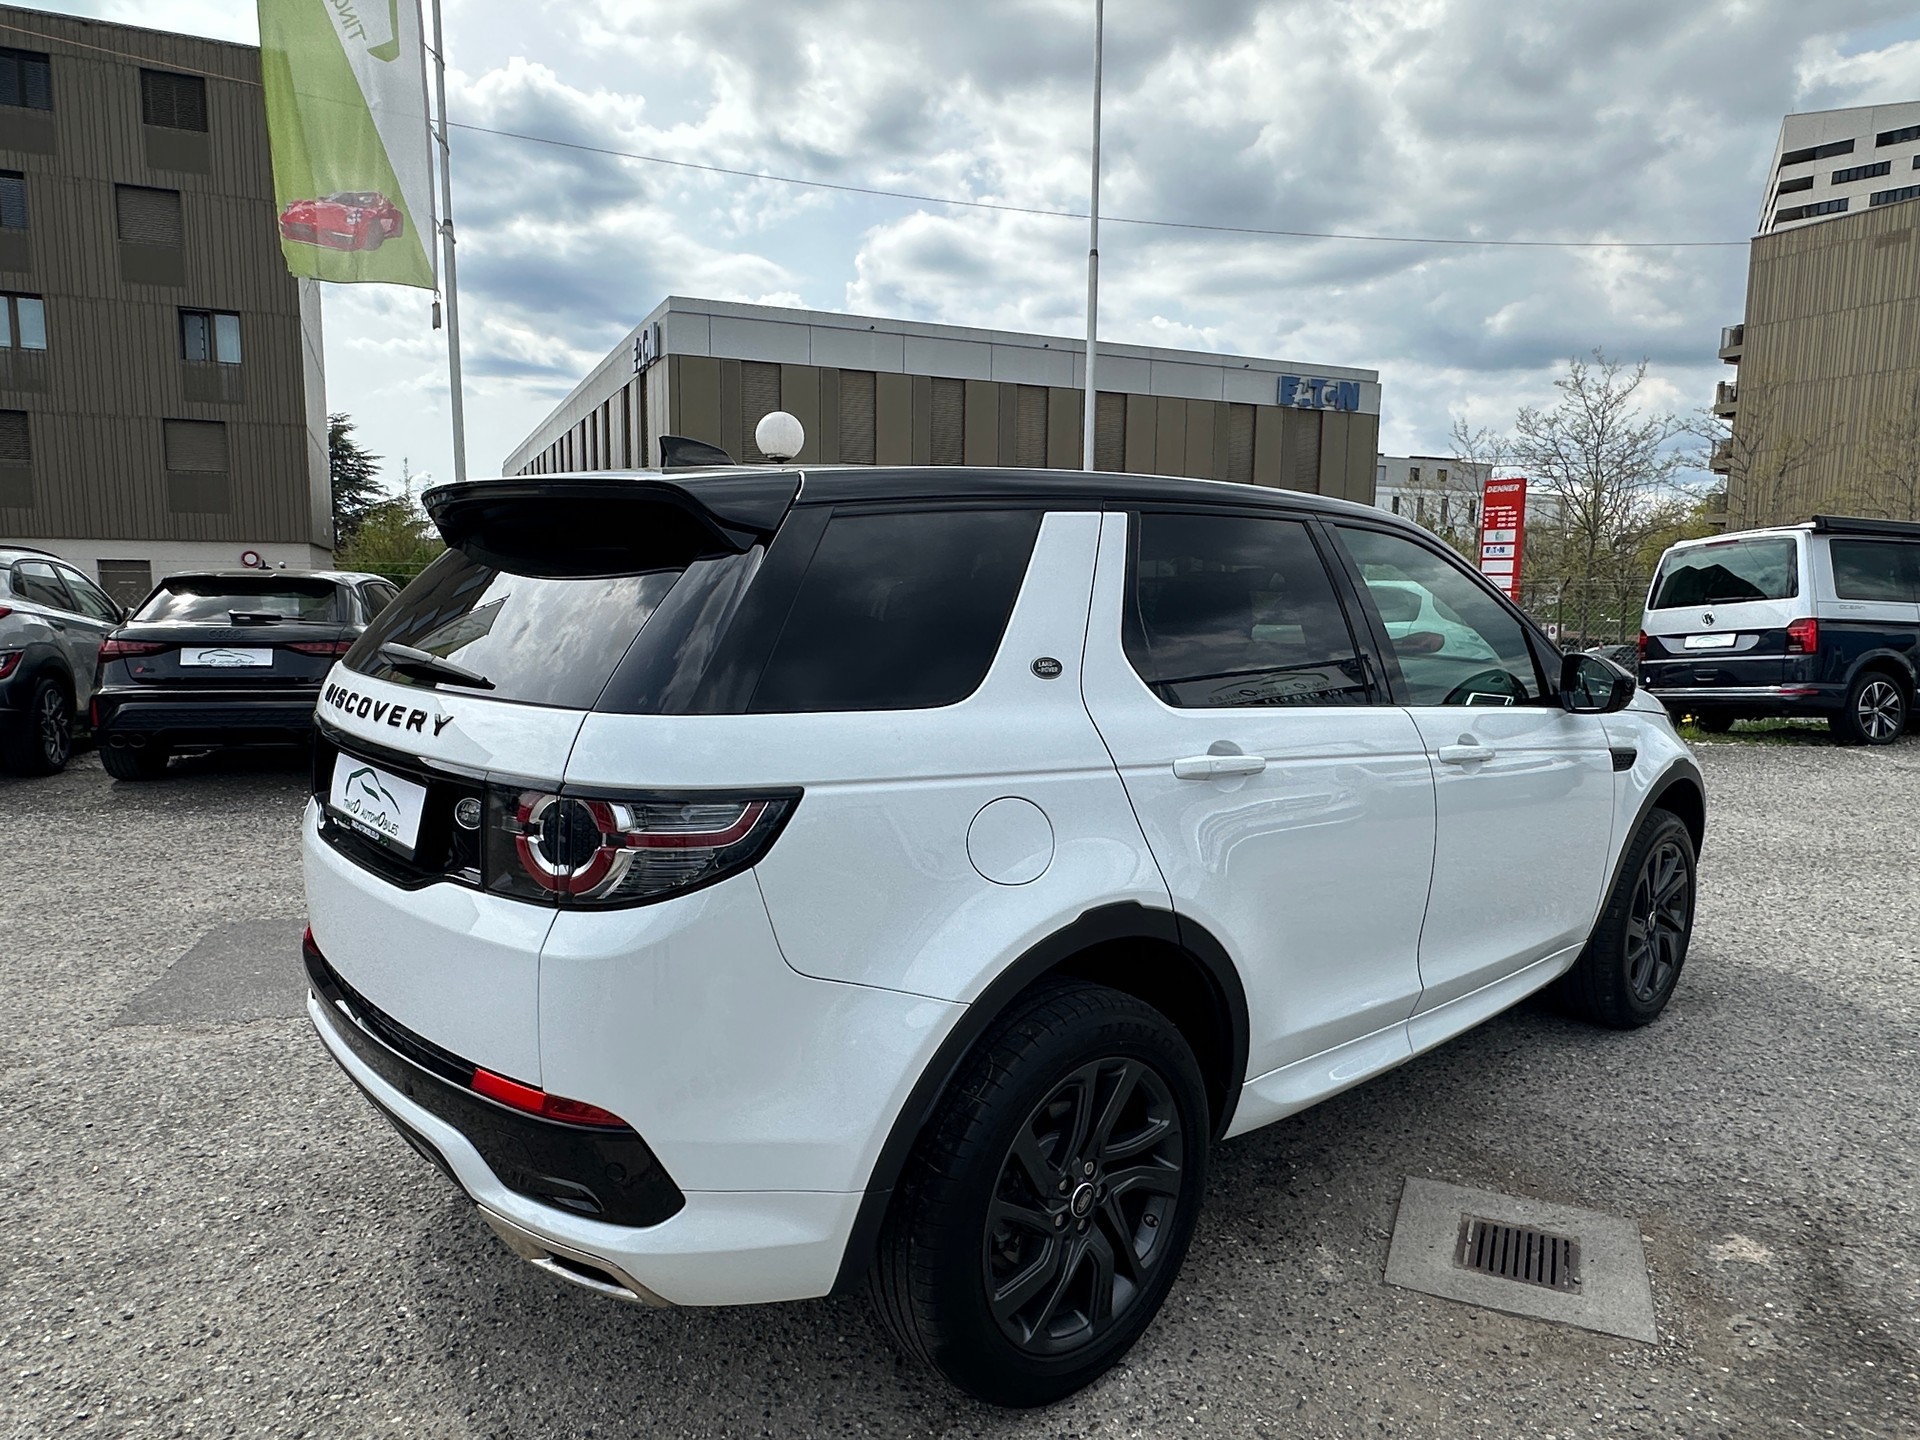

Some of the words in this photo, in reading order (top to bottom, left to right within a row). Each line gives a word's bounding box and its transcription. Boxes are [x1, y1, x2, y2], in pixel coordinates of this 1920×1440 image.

[1278, 375, 1361, 411] EATON
[1486, 484, 1520, 493] DENNER
[325, 683, 454, 737] DISCOVERY
